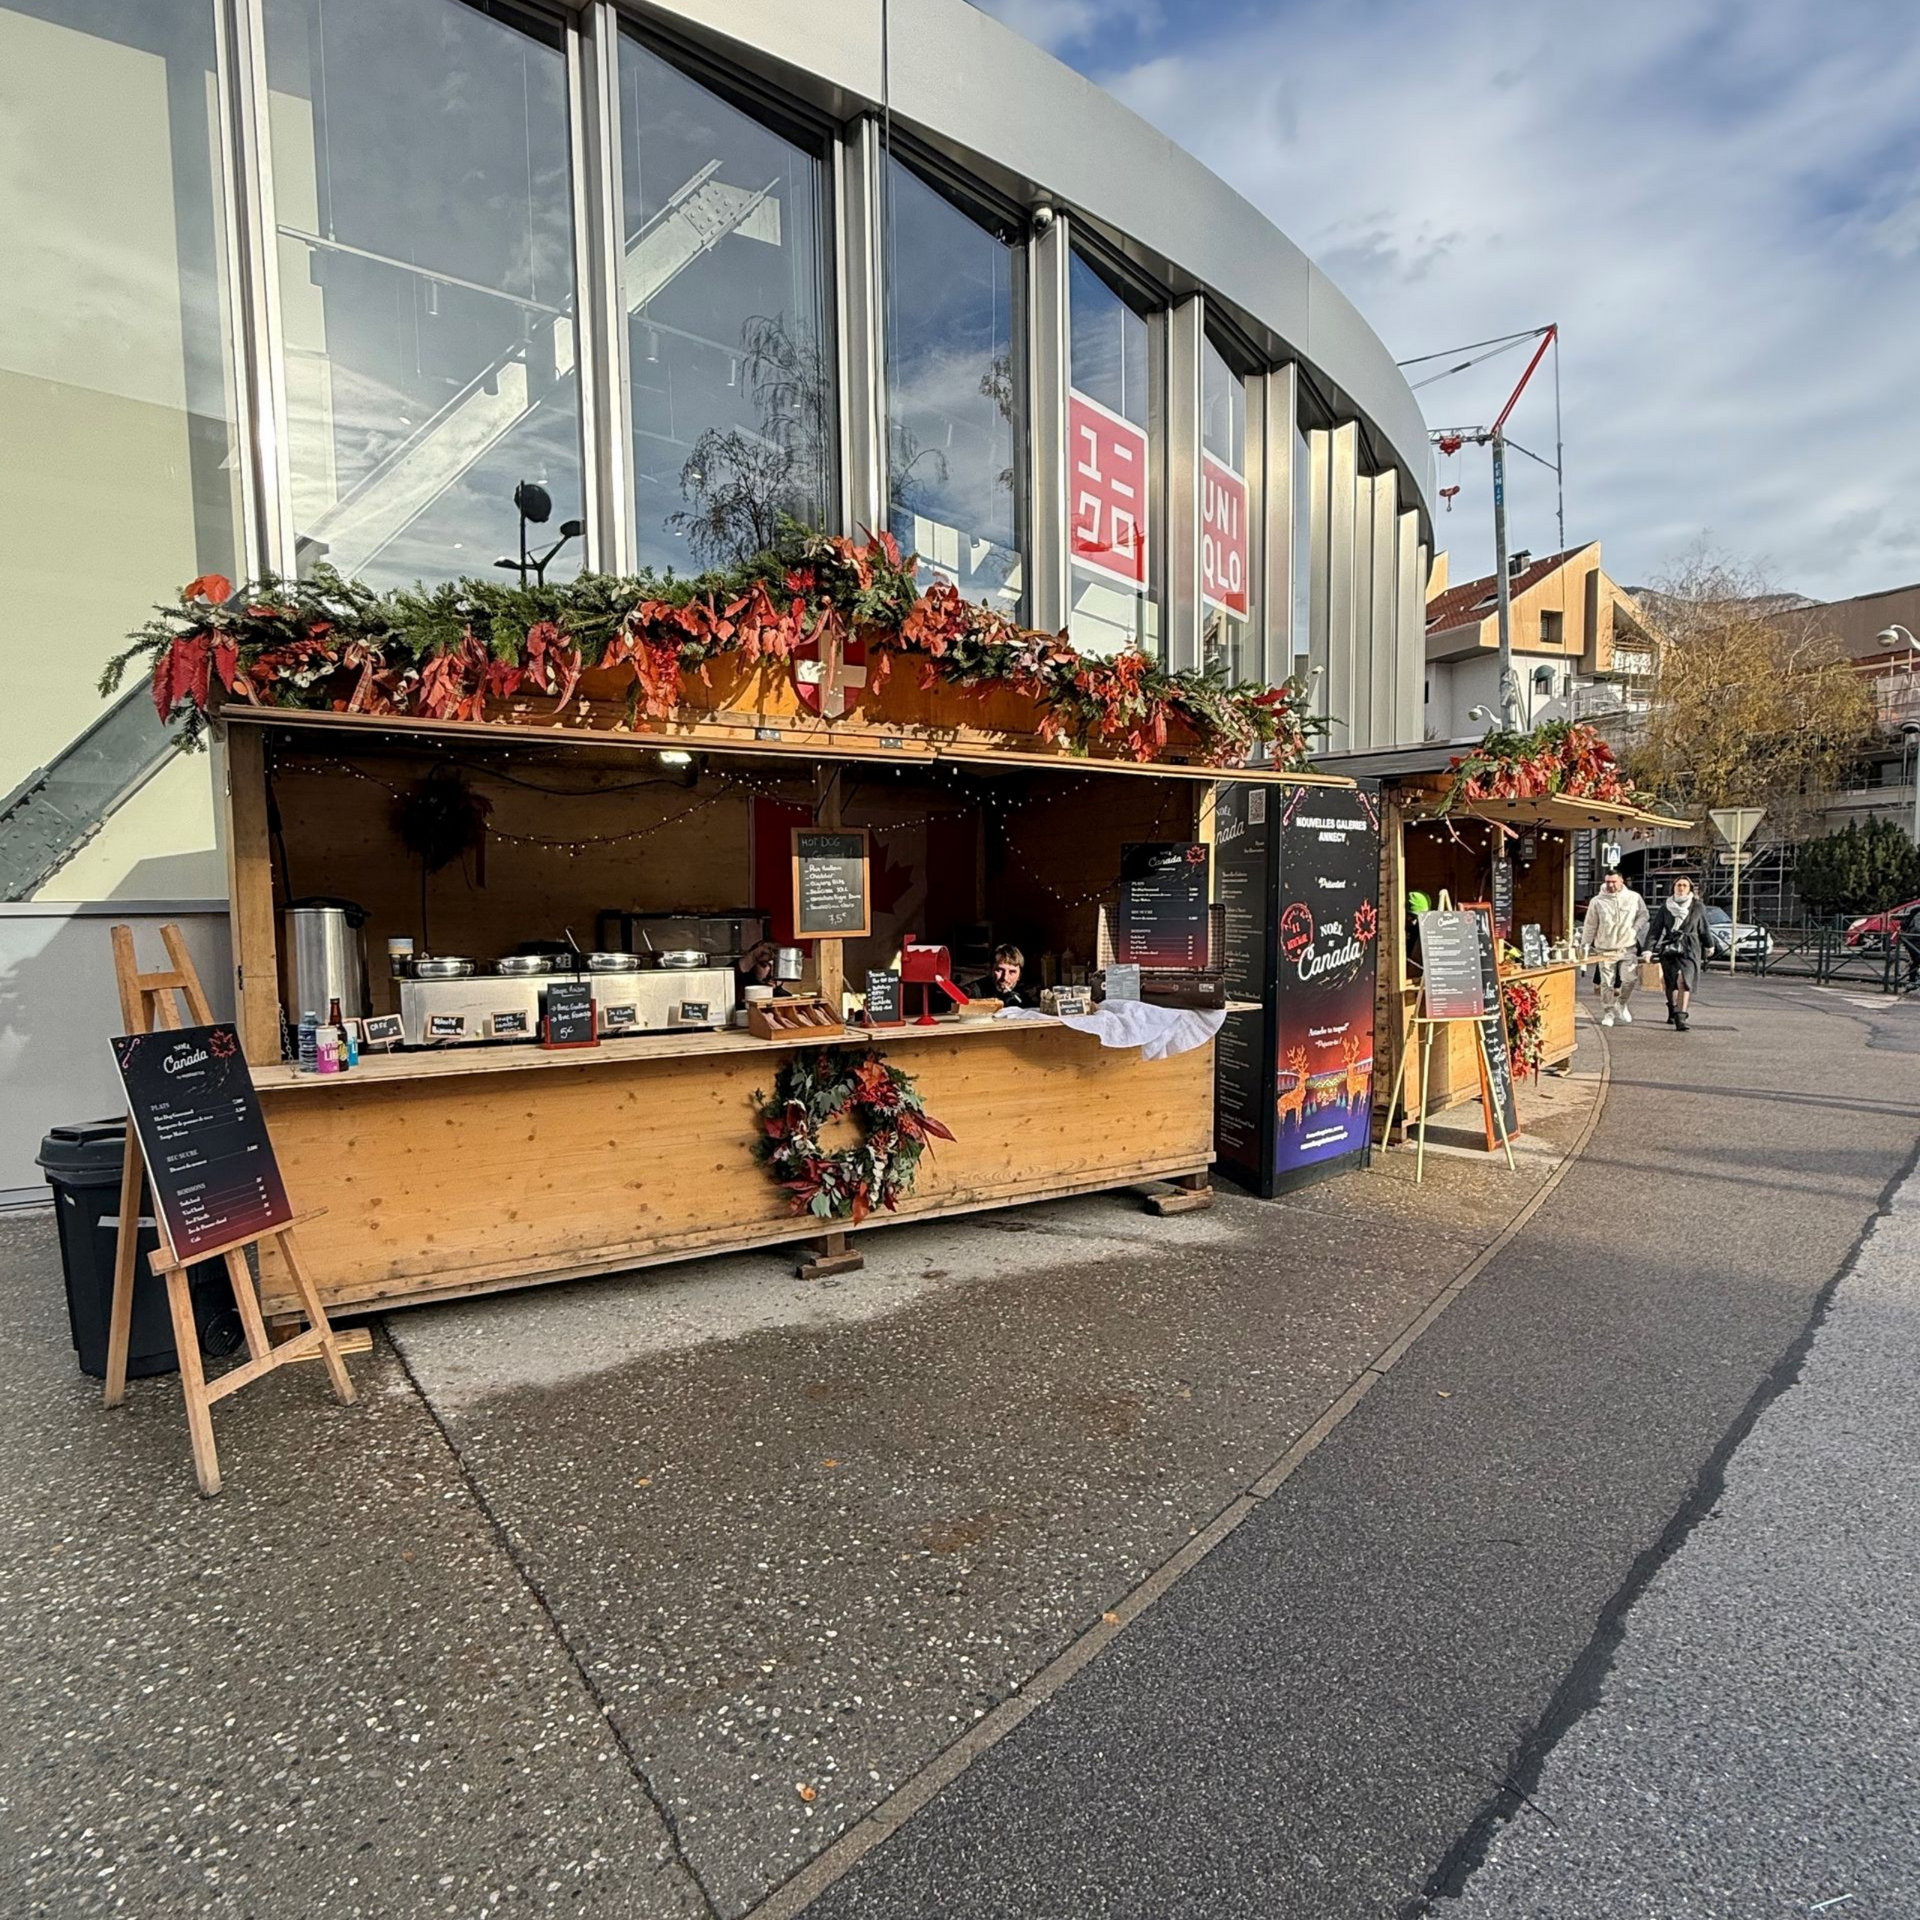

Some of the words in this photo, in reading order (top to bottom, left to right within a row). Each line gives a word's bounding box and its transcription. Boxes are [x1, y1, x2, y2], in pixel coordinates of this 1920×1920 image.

[1203, 475, 1238, 540] UNI
[1203, 533, 1241, 593] QLO
[1296, 816, 1335, 829] NOUVELLES
[1336, 818, 1367, 831] GALERIES
[801, 837, 818, 848] HOT
[820, 836, 841, 847] DOG
[1318, 831, 1346, 843] ANNECY
[1148, 855, 1182, 867] Canada
[1319, 921, 1343, 938] NOËL
[1298, 936, 1360, 981] Canada
[163, 1048, 209, 1073] Canada
[150, 1102, 170, 1111] PLATS
[176, 1183, 207, 1196] BOISSONS
